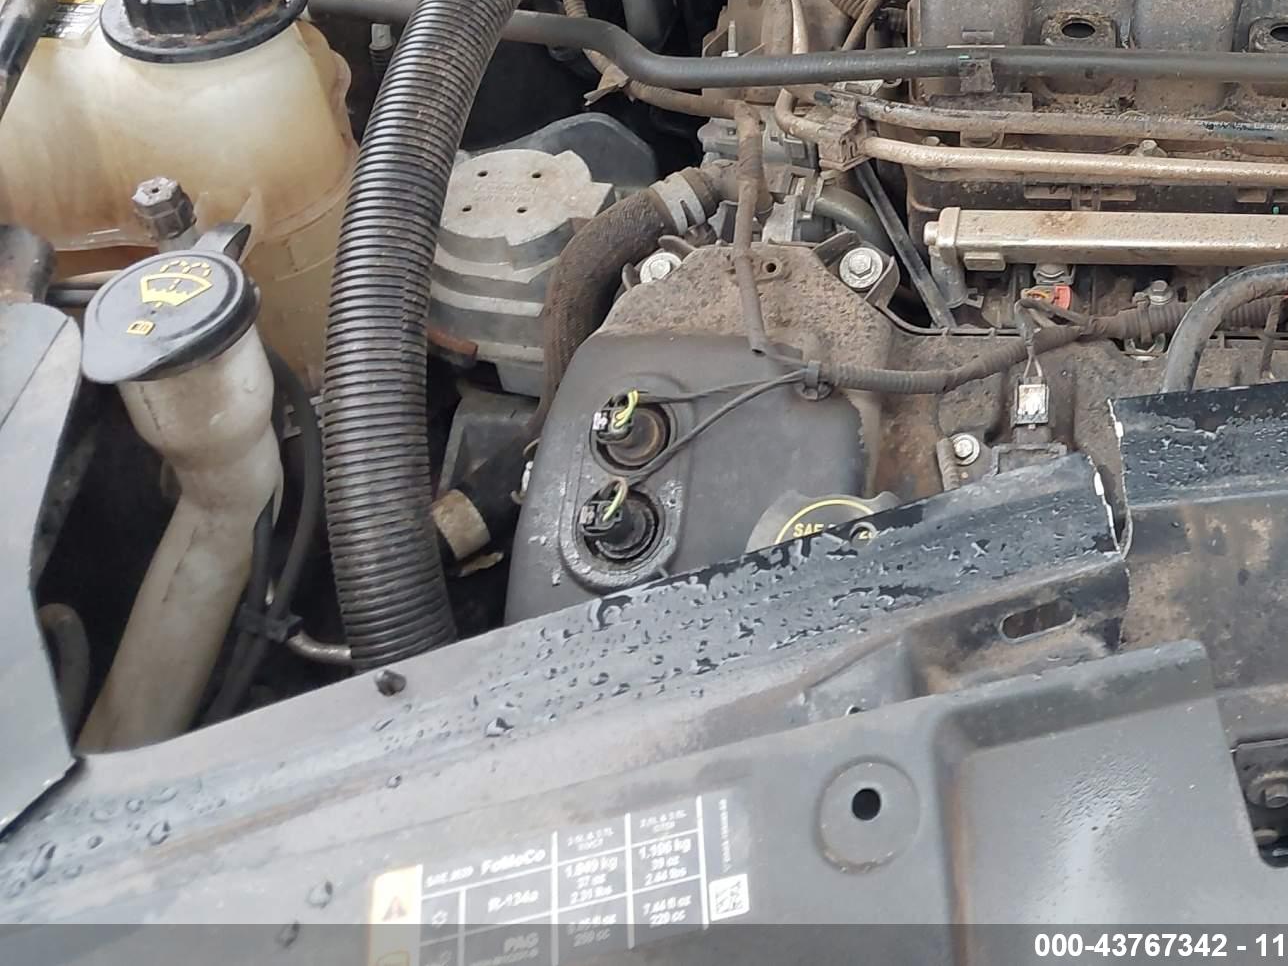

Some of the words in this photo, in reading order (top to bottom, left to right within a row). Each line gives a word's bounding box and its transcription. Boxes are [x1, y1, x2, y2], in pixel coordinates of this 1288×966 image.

[673, 838, 691, 853] kg
[480, 849, 546, 876] FoMoCo
[600, 857, 618, 874] kg
[666, 855, 681, 868] oz
[591, 873, 607, 886] oz
[488, 890, 539, 913] R-134a
